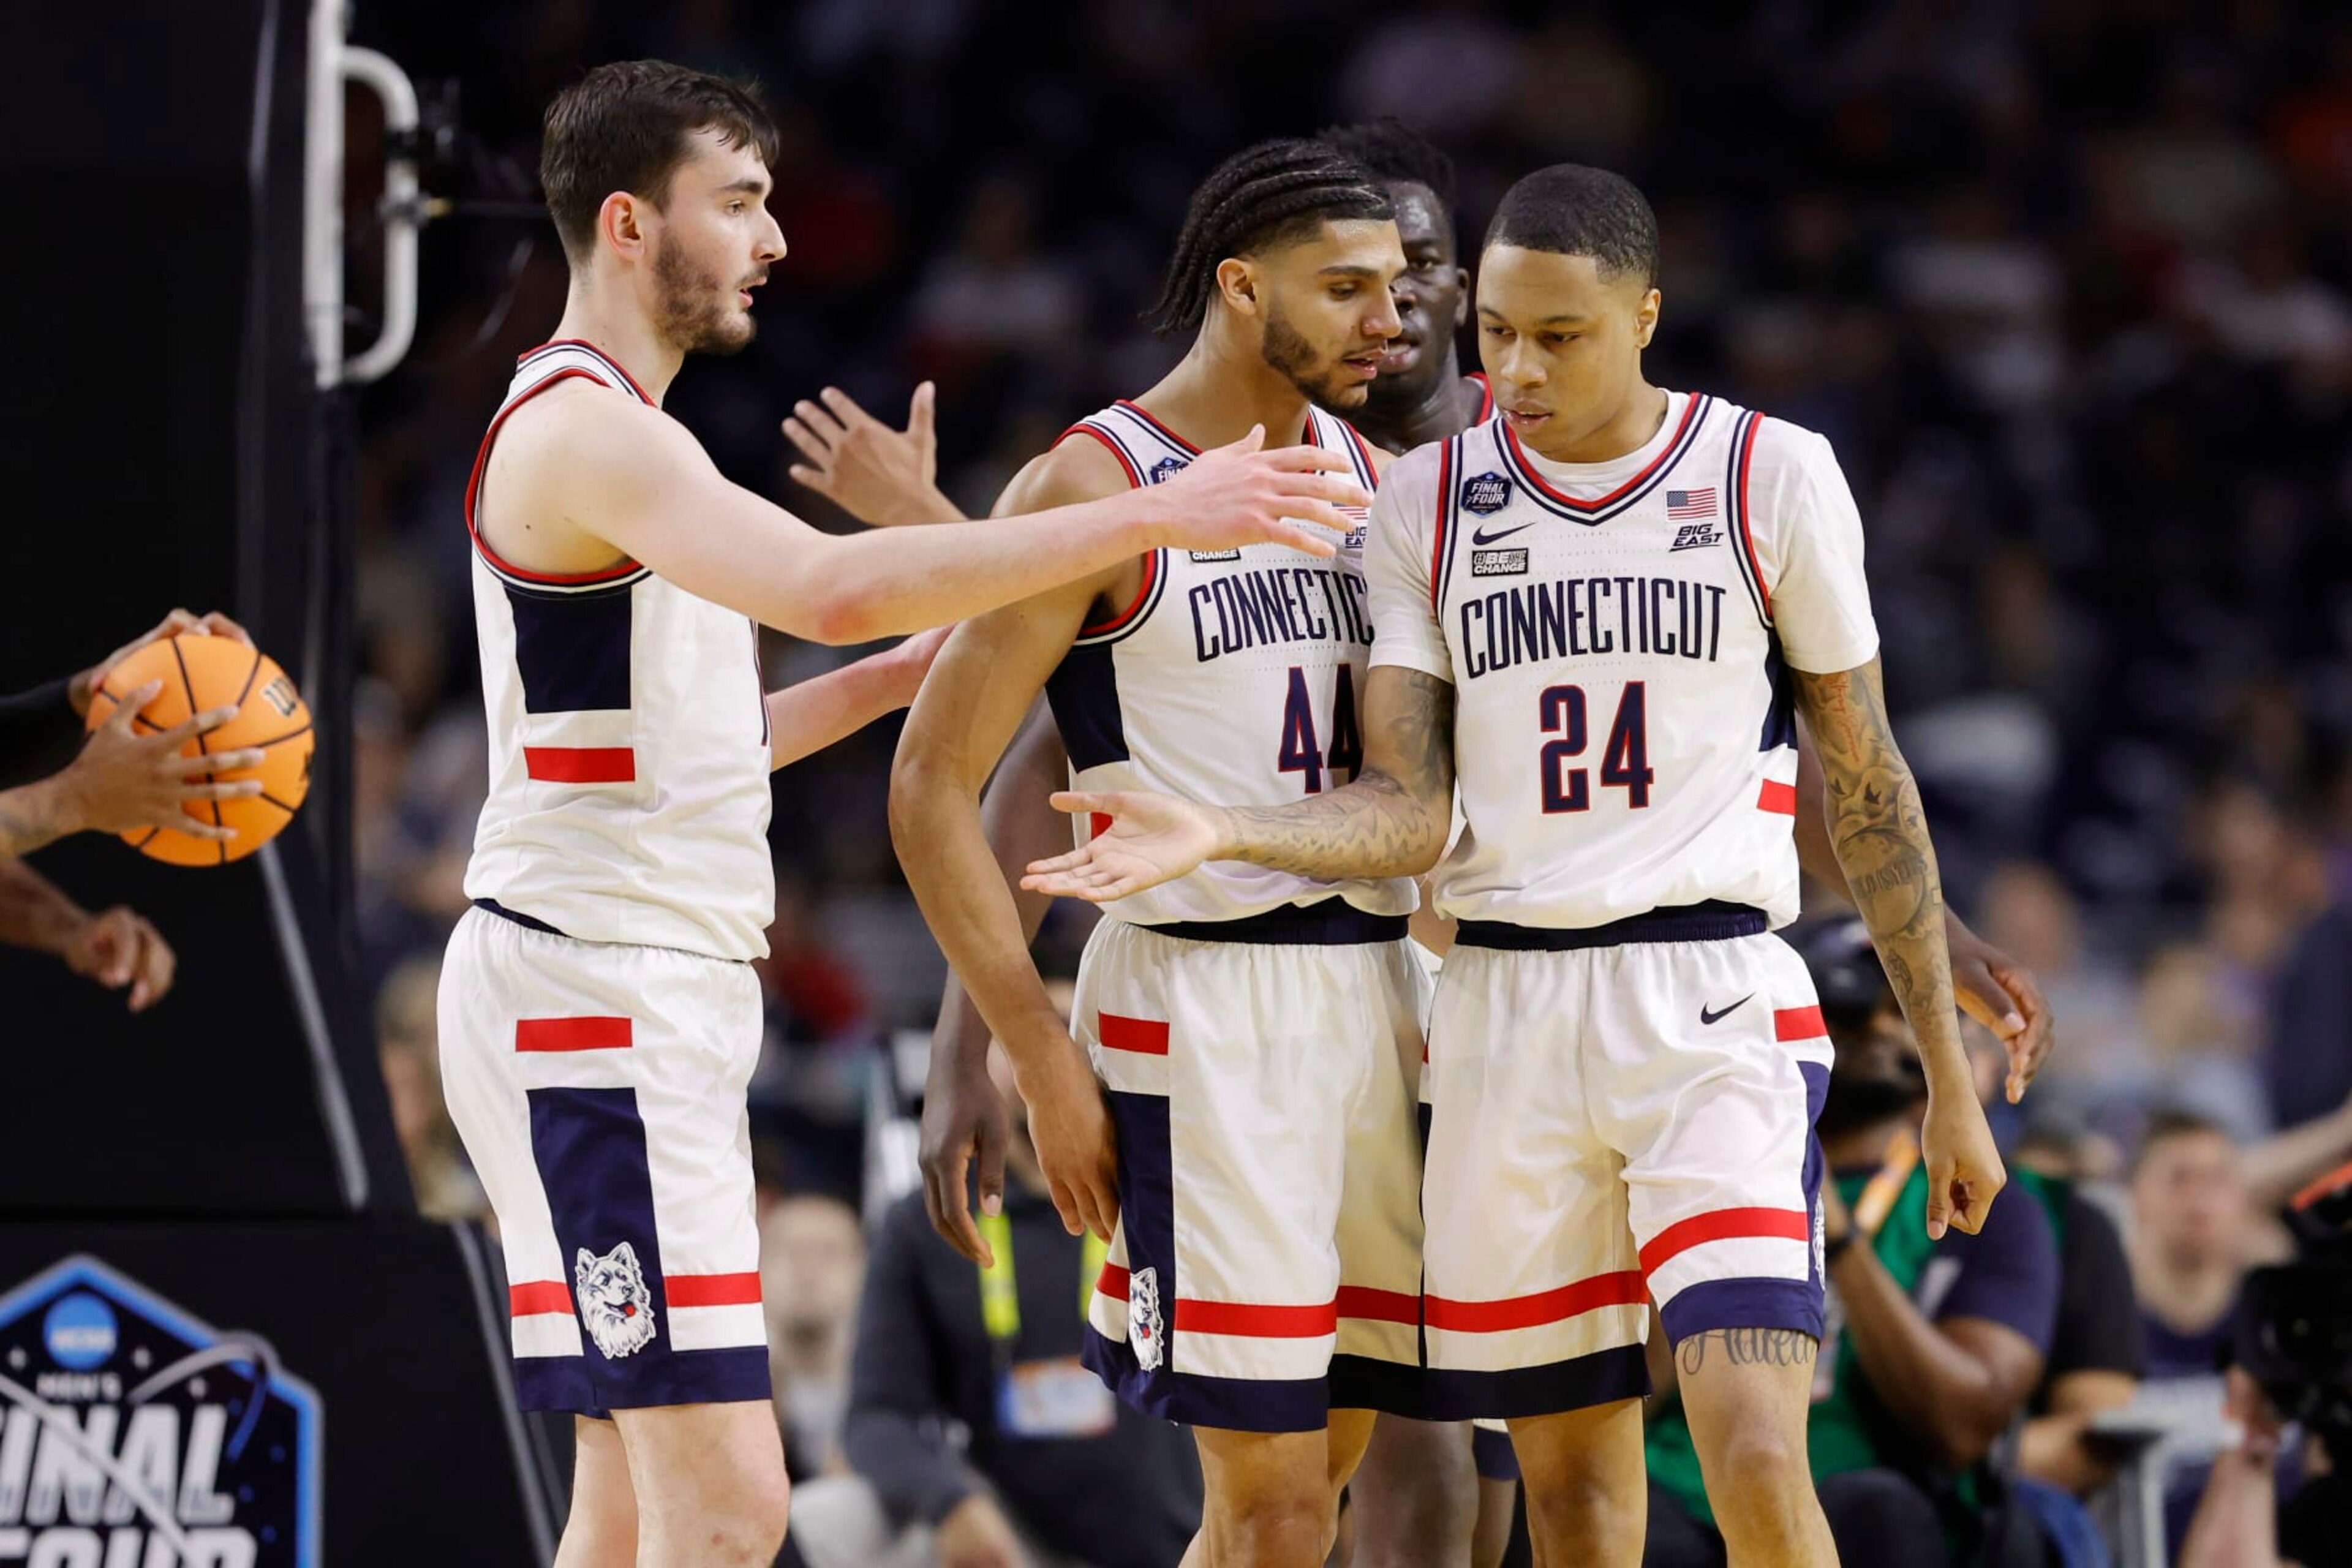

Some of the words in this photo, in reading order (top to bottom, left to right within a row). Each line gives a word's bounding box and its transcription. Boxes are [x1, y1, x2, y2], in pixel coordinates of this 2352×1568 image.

[1471, 483, 1504, 493] FINAL
[1472, 493, 1505, 504] FOUR
[1677, 523, 1714, 537] BIG
[1345, 537, 1366, 546] EA
[1673, 532, 1725, 547] EAST
[1192, 549, 1237, 560] CHANGE
[1474, 562, 1526, 574] CHANGE
[1188, 567, 1375, 662] CONNECTIC
[1460, 577, 1726, 679] CONNECTICUT
[1278, 663, 1365, 794] 44
[1539, 680, 1654, 815] 24
[0, 1404, 236, 1526] INAL
